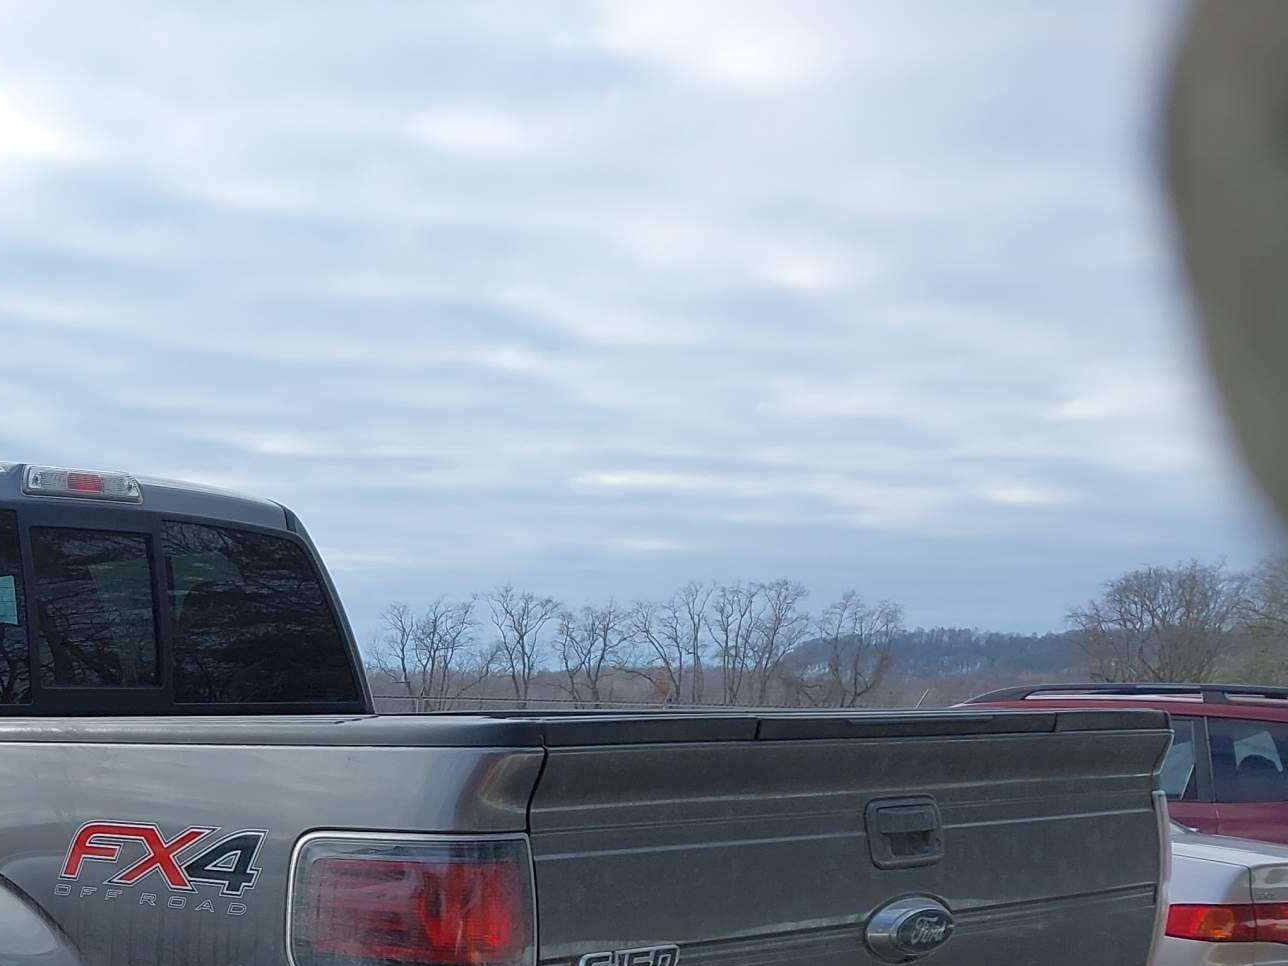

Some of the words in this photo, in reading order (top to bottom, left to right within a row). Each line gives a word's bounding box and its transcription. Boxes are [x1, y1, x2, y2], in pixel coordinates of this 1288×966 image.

[59, 820, 269, 897] FX4
[54, 884, 123, 901] OFF
[139, 893, 248, 916] ROAD
[911, 916, 947, 944] Ford
